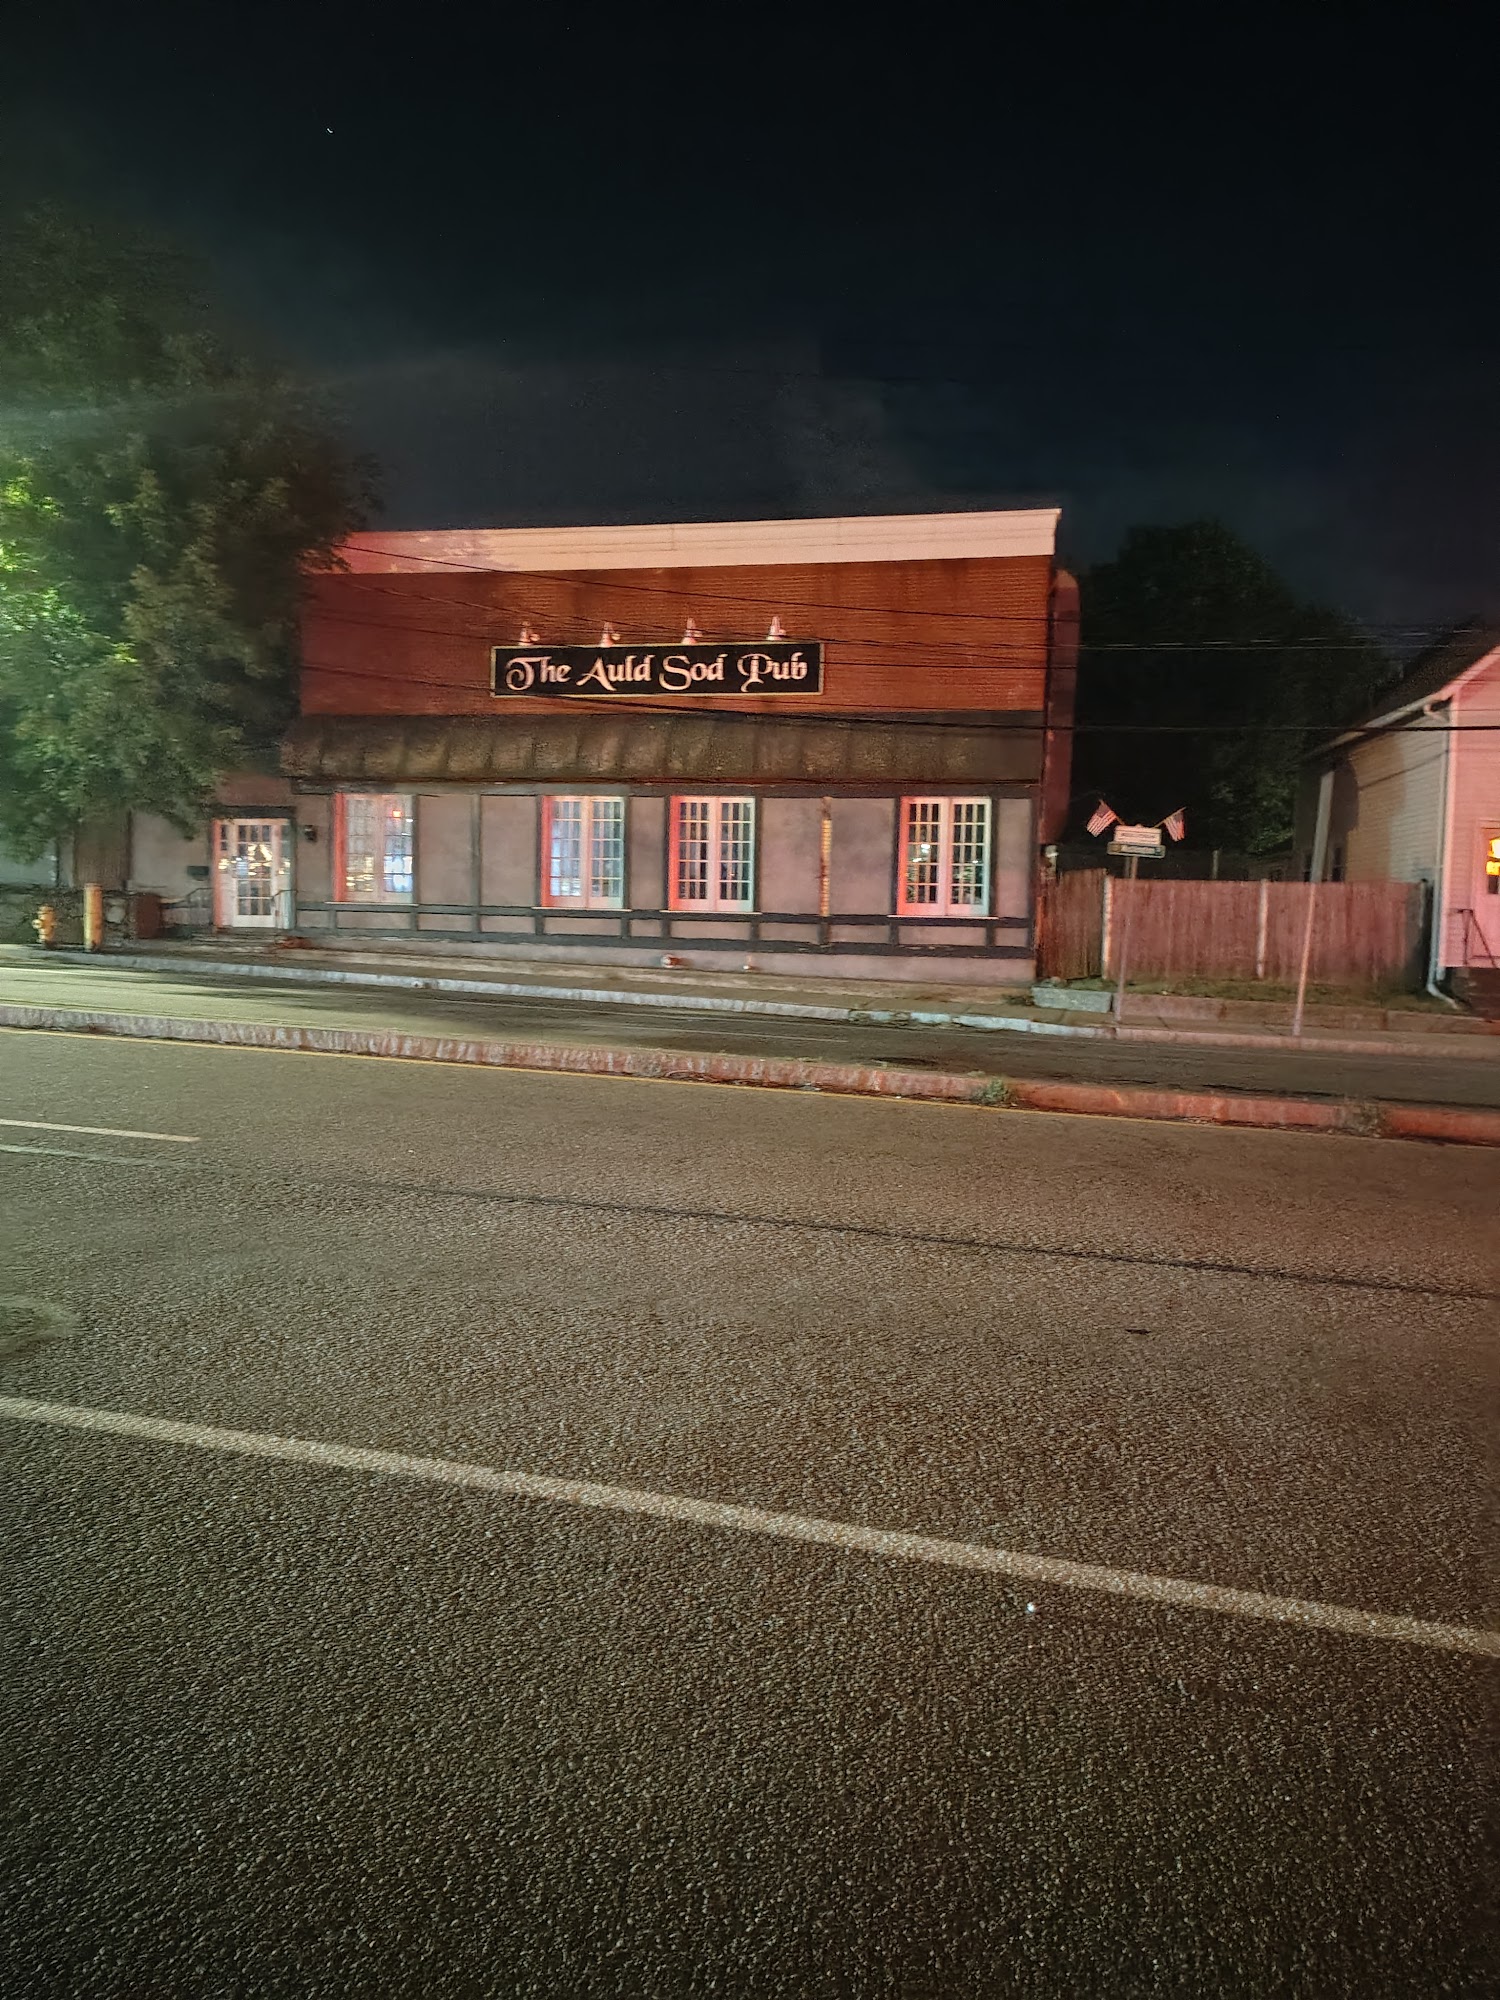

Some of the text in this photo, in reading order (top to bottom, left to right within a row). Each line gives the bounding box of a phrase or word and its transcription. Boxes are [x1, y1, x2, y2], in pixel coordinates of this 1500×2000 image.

[505, 652, 808, 692] The Auld Sod Pub
